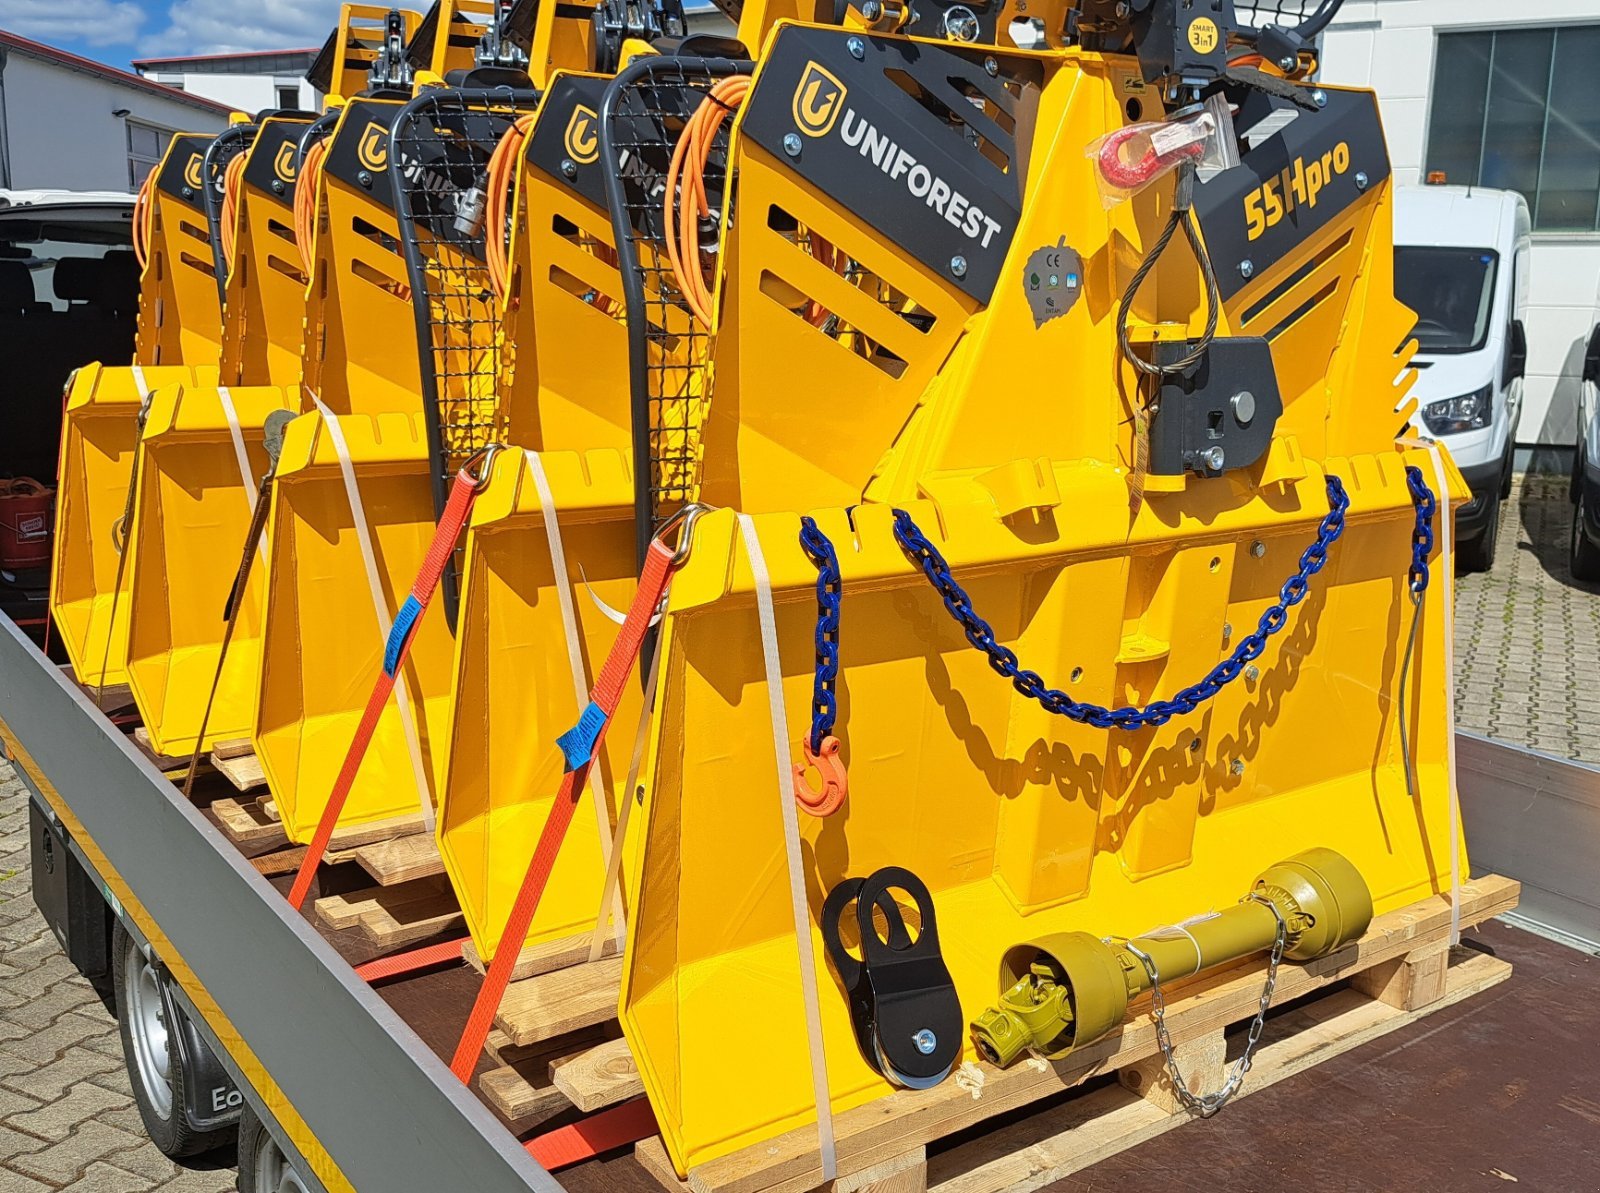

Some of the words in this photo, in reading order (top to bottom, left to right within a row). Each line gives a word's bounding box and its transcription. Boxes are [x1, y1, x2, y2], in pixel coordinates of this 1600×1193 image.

[1192, 24, 1214, 32] SMART
[841, 108, 1001, 249] UNIFOREST
[1243, 142, 1350, 241] 55Hpro
